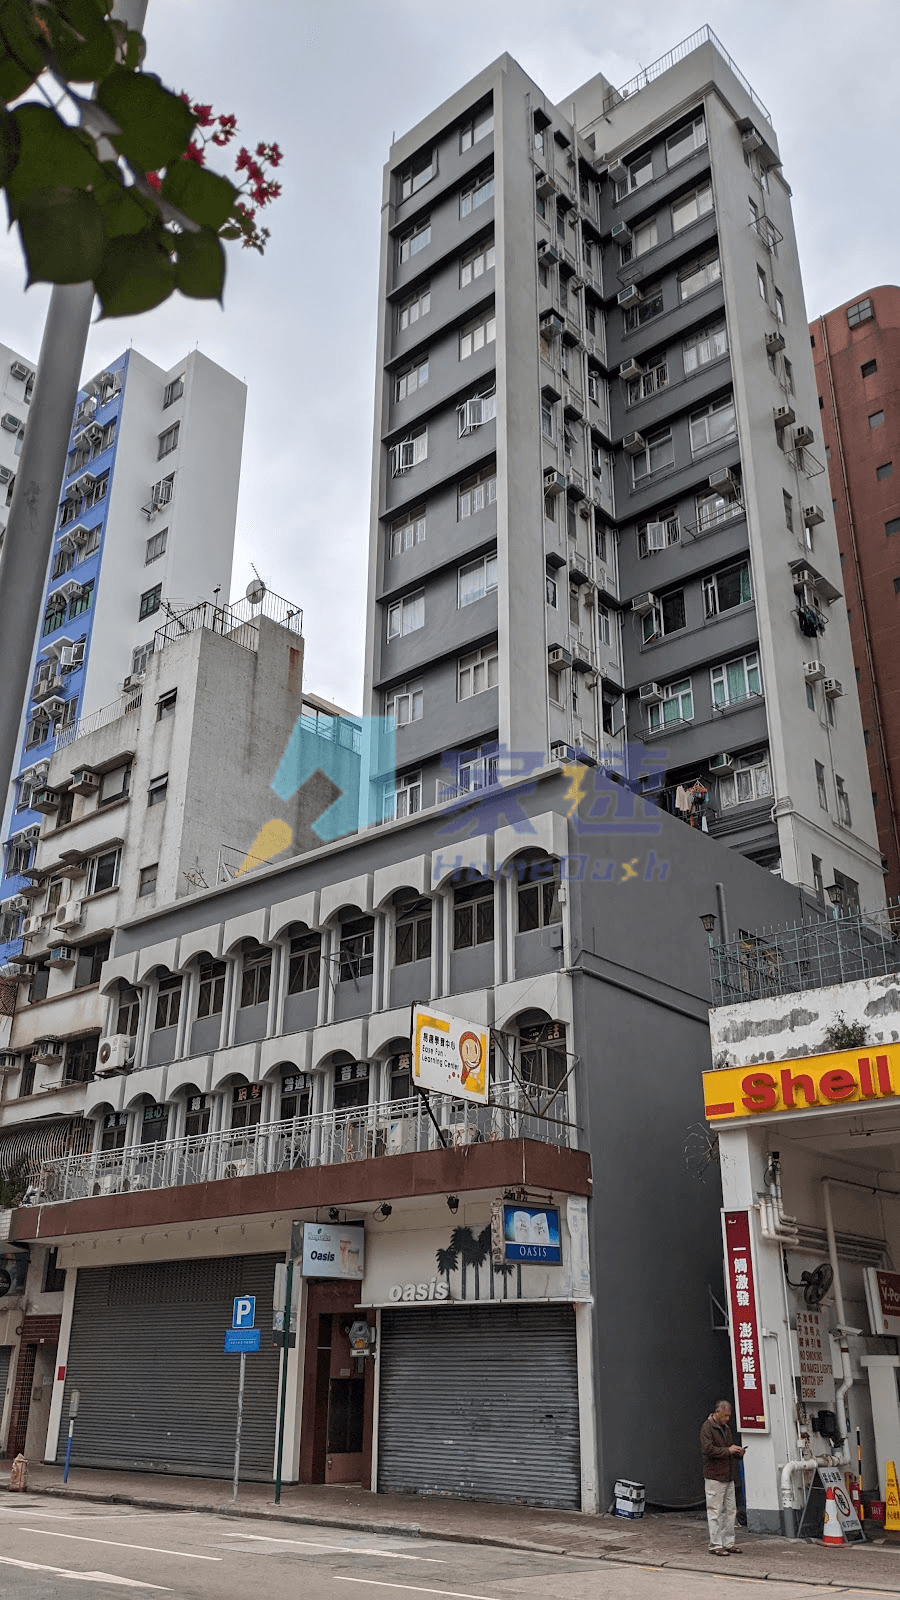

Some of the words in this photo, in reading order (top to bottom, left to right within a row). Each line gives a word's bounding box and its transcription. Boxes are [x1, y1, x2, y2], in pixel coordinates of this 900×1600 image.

[421, 1054, 443, 1067] Learning
[341, 1061, 368, 1081] 音樂
[741, 1055, 892, 1111] Shell
[310, 1250, 335, 1261] Oasis
[519, 1245, 547, 1257] OASIS
[388, 1276, 449, 1301] oasis
[881, 1286, 900, 1302] V-Po
[236, 1300, 251, 1325] P
[738, 1322, 757, 1390] 澎湃能量
[806, 1350, 823, 1361] SMOKING
[820, 1363, 833, 1375] LIGHTS
[816, 1376, 824, 1386] OFF
[802, 1388, 816, 1398] ENGINE
